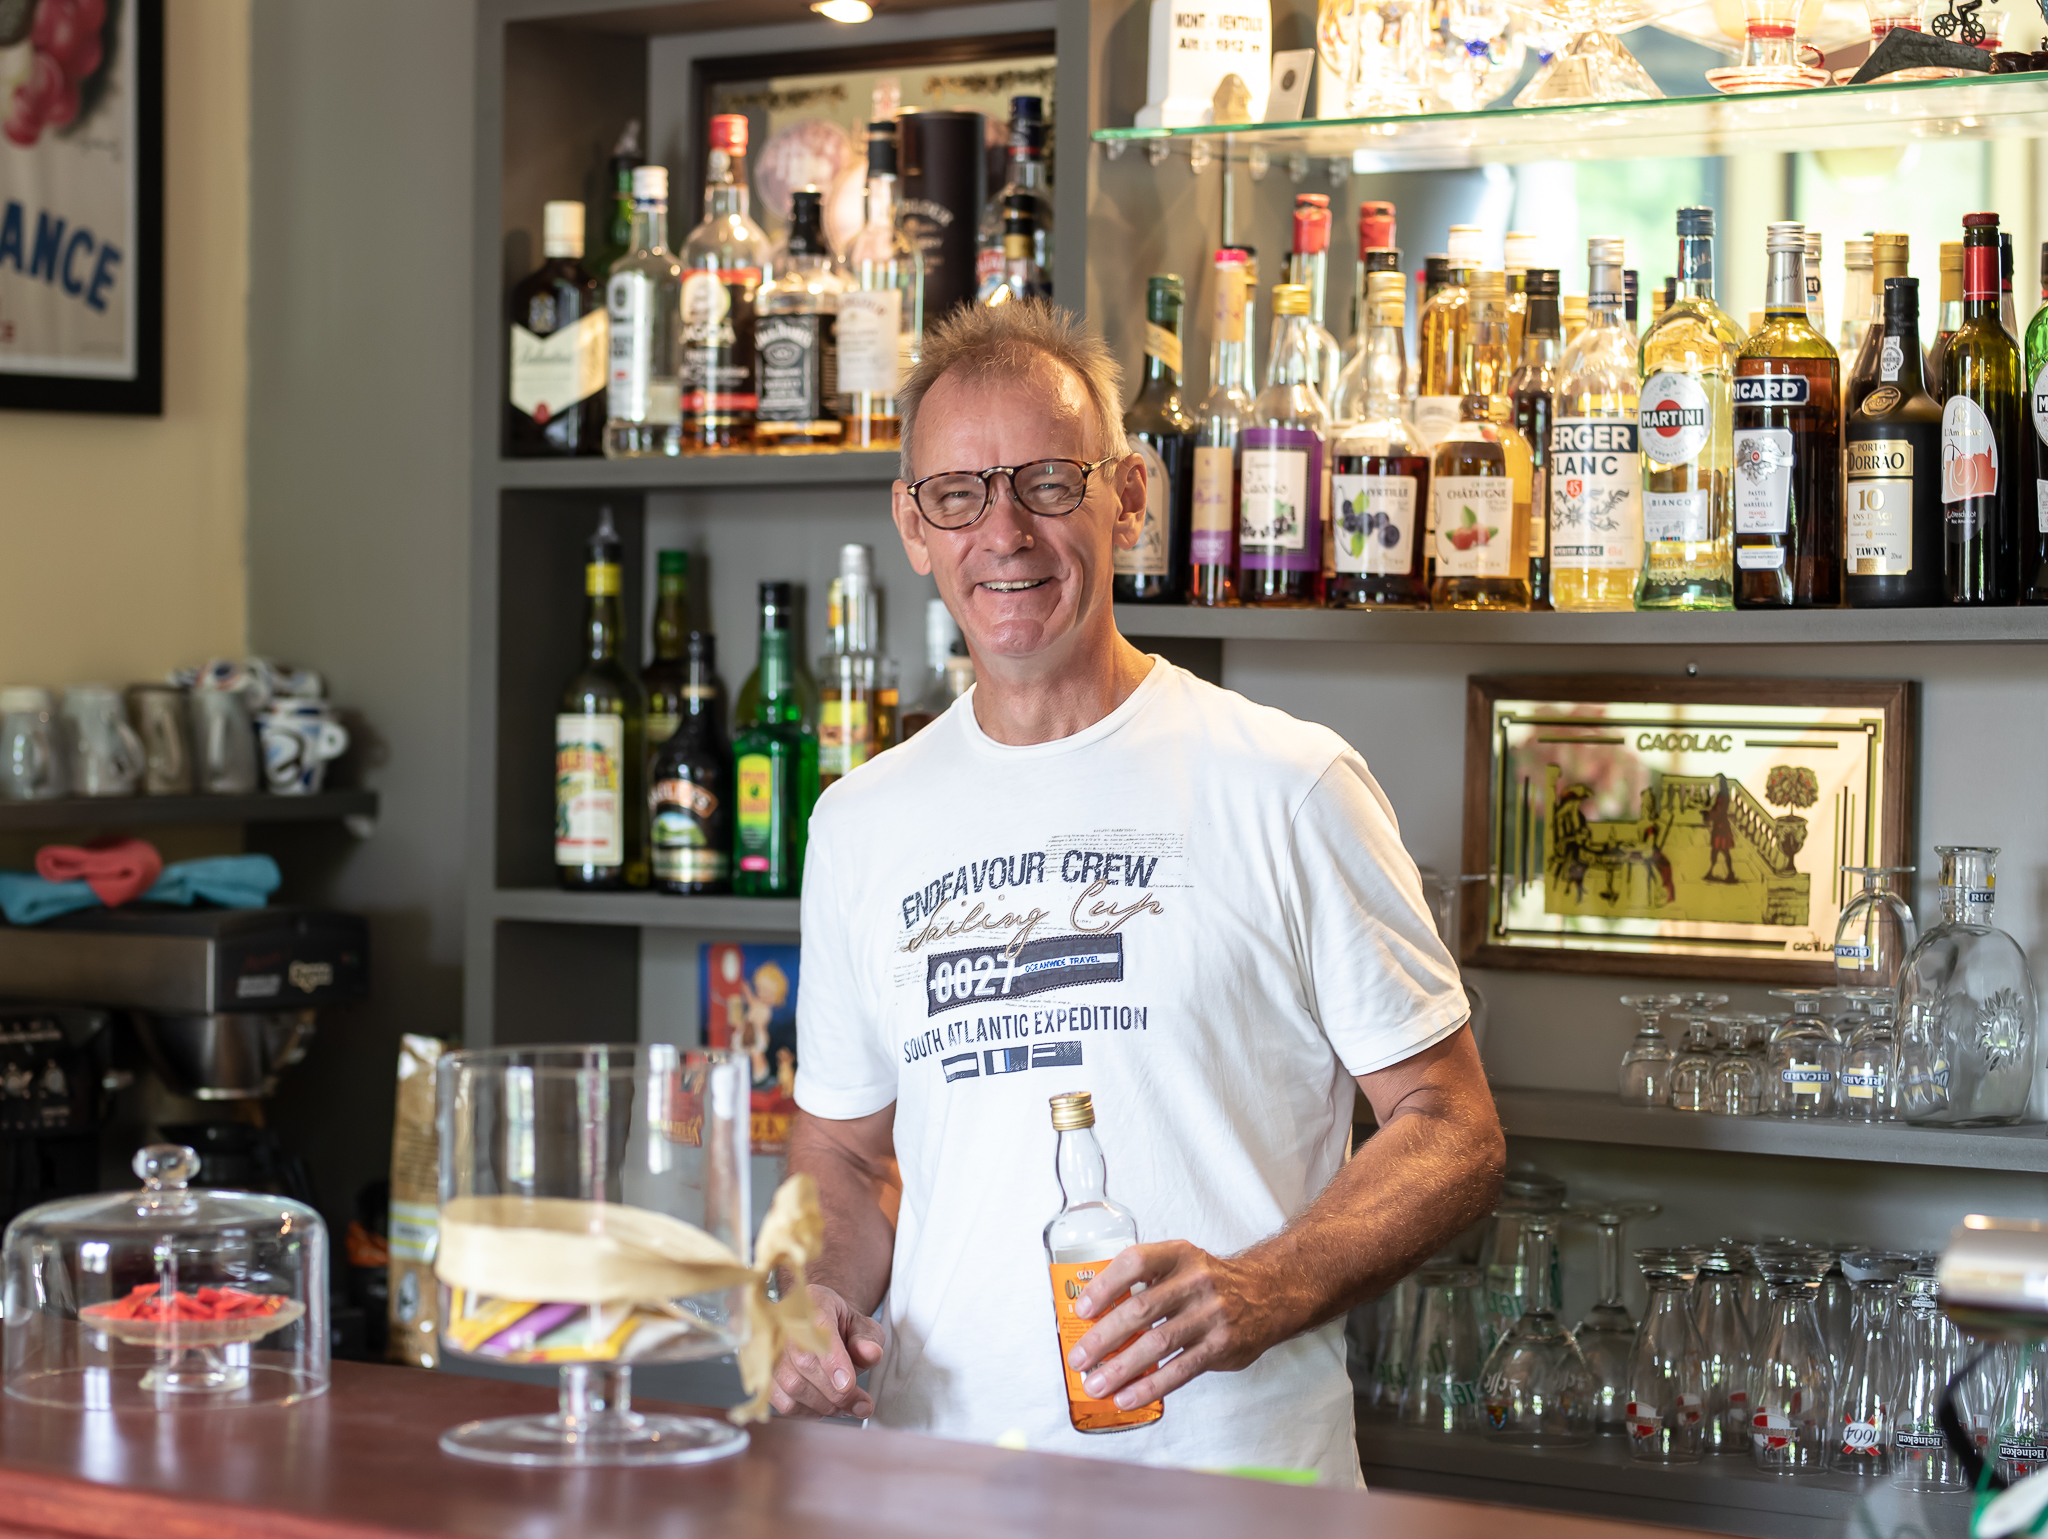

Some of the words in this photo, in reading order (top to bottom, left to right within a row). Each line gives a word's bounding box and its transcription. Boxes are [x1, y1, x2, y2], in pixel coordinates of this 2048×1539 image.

[1643, 410, 1702, 427] MARTINI
[1858, 443, 1887, 453] PORTO
[1447, 487, 1507, 499] CHÂTAIGNE
[1858, 488, 1886, 511] 10
[1855, 547, 1887, 556] TAWNY
[1636, 733, 1733, 753] CACOLAC
[902, 851, 1046, 930] ENDEAVOUR
[1061, 849, 1159, 888] CREW
[900, 893, 1051, 960] Sailing
[1070, 878, 1164, 936] Cup
[1025, 958, 1066, 973] OCEANWIDE
[1070, 955, 1101, 966] TRAVEL
[935, 952, 1016, 1003] 0027
[903, 1028, 944, 1063] SOUTH
[948, 1013, 1029, 1047] ATLANTIC
[1034, 1006, 1148, 1034] EXPEDITION
[1783, 1071, 1830, 1082] RICARD
[1844, 1428, 1878, 1444] 1664
[1898, 1434, 1941, 1446] Heineken
[2001, 1446, 2045, 1459] Heineken
